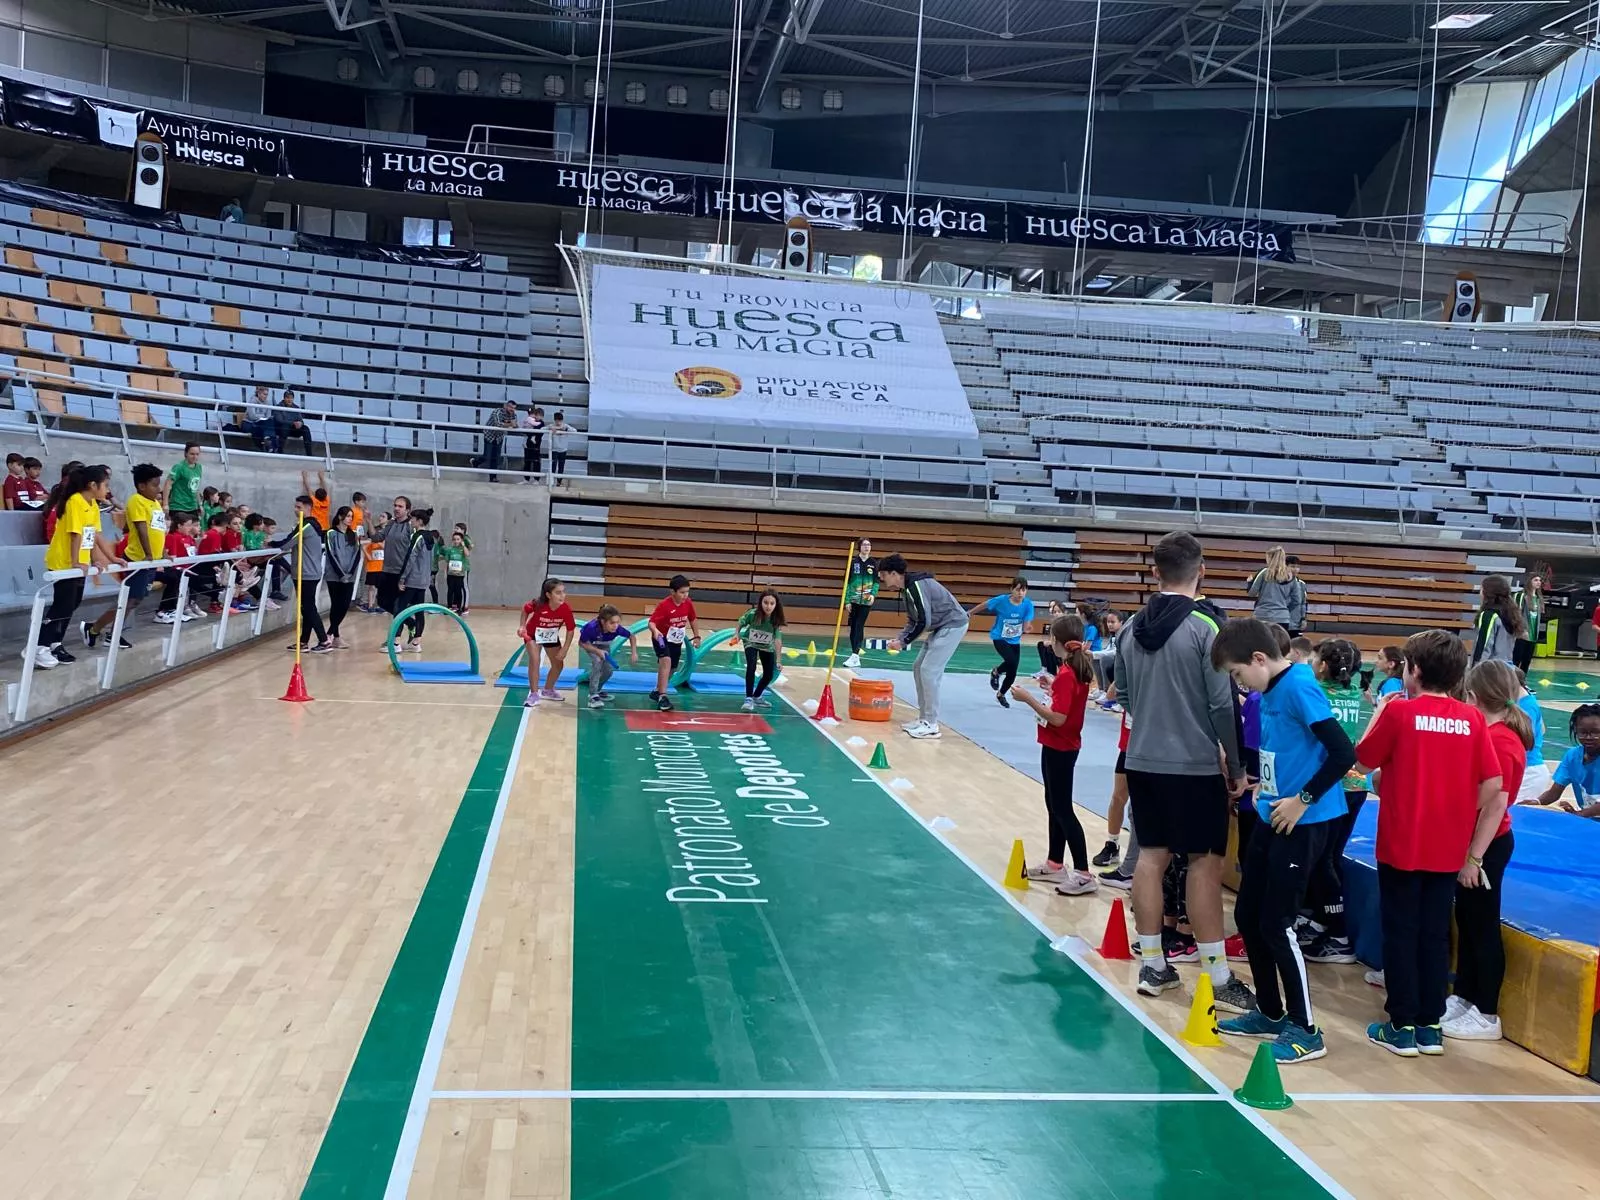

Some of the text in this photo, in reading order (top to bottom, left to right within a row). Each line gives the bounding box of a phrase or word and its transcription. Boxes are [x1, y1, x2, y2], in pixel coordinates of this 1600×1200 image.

[147, 116, 275, 152] Ayuntamiento
[175, 141, 245, 167] Huesca
[757, 376, 888, 392] DIPUTACIÓN
[758, 386, 889, 402] HUESCA
[538, 631, 555, 639] 427
[1327, 699, 1360, 708] LETISMO
[1415, 715, 1471, 736] MARCOS
[718, 733, 830, 827] de Deportes
[629, 731, 768, 903] Patronato Municipal
[1324, 904, 1344, 914] PUM
